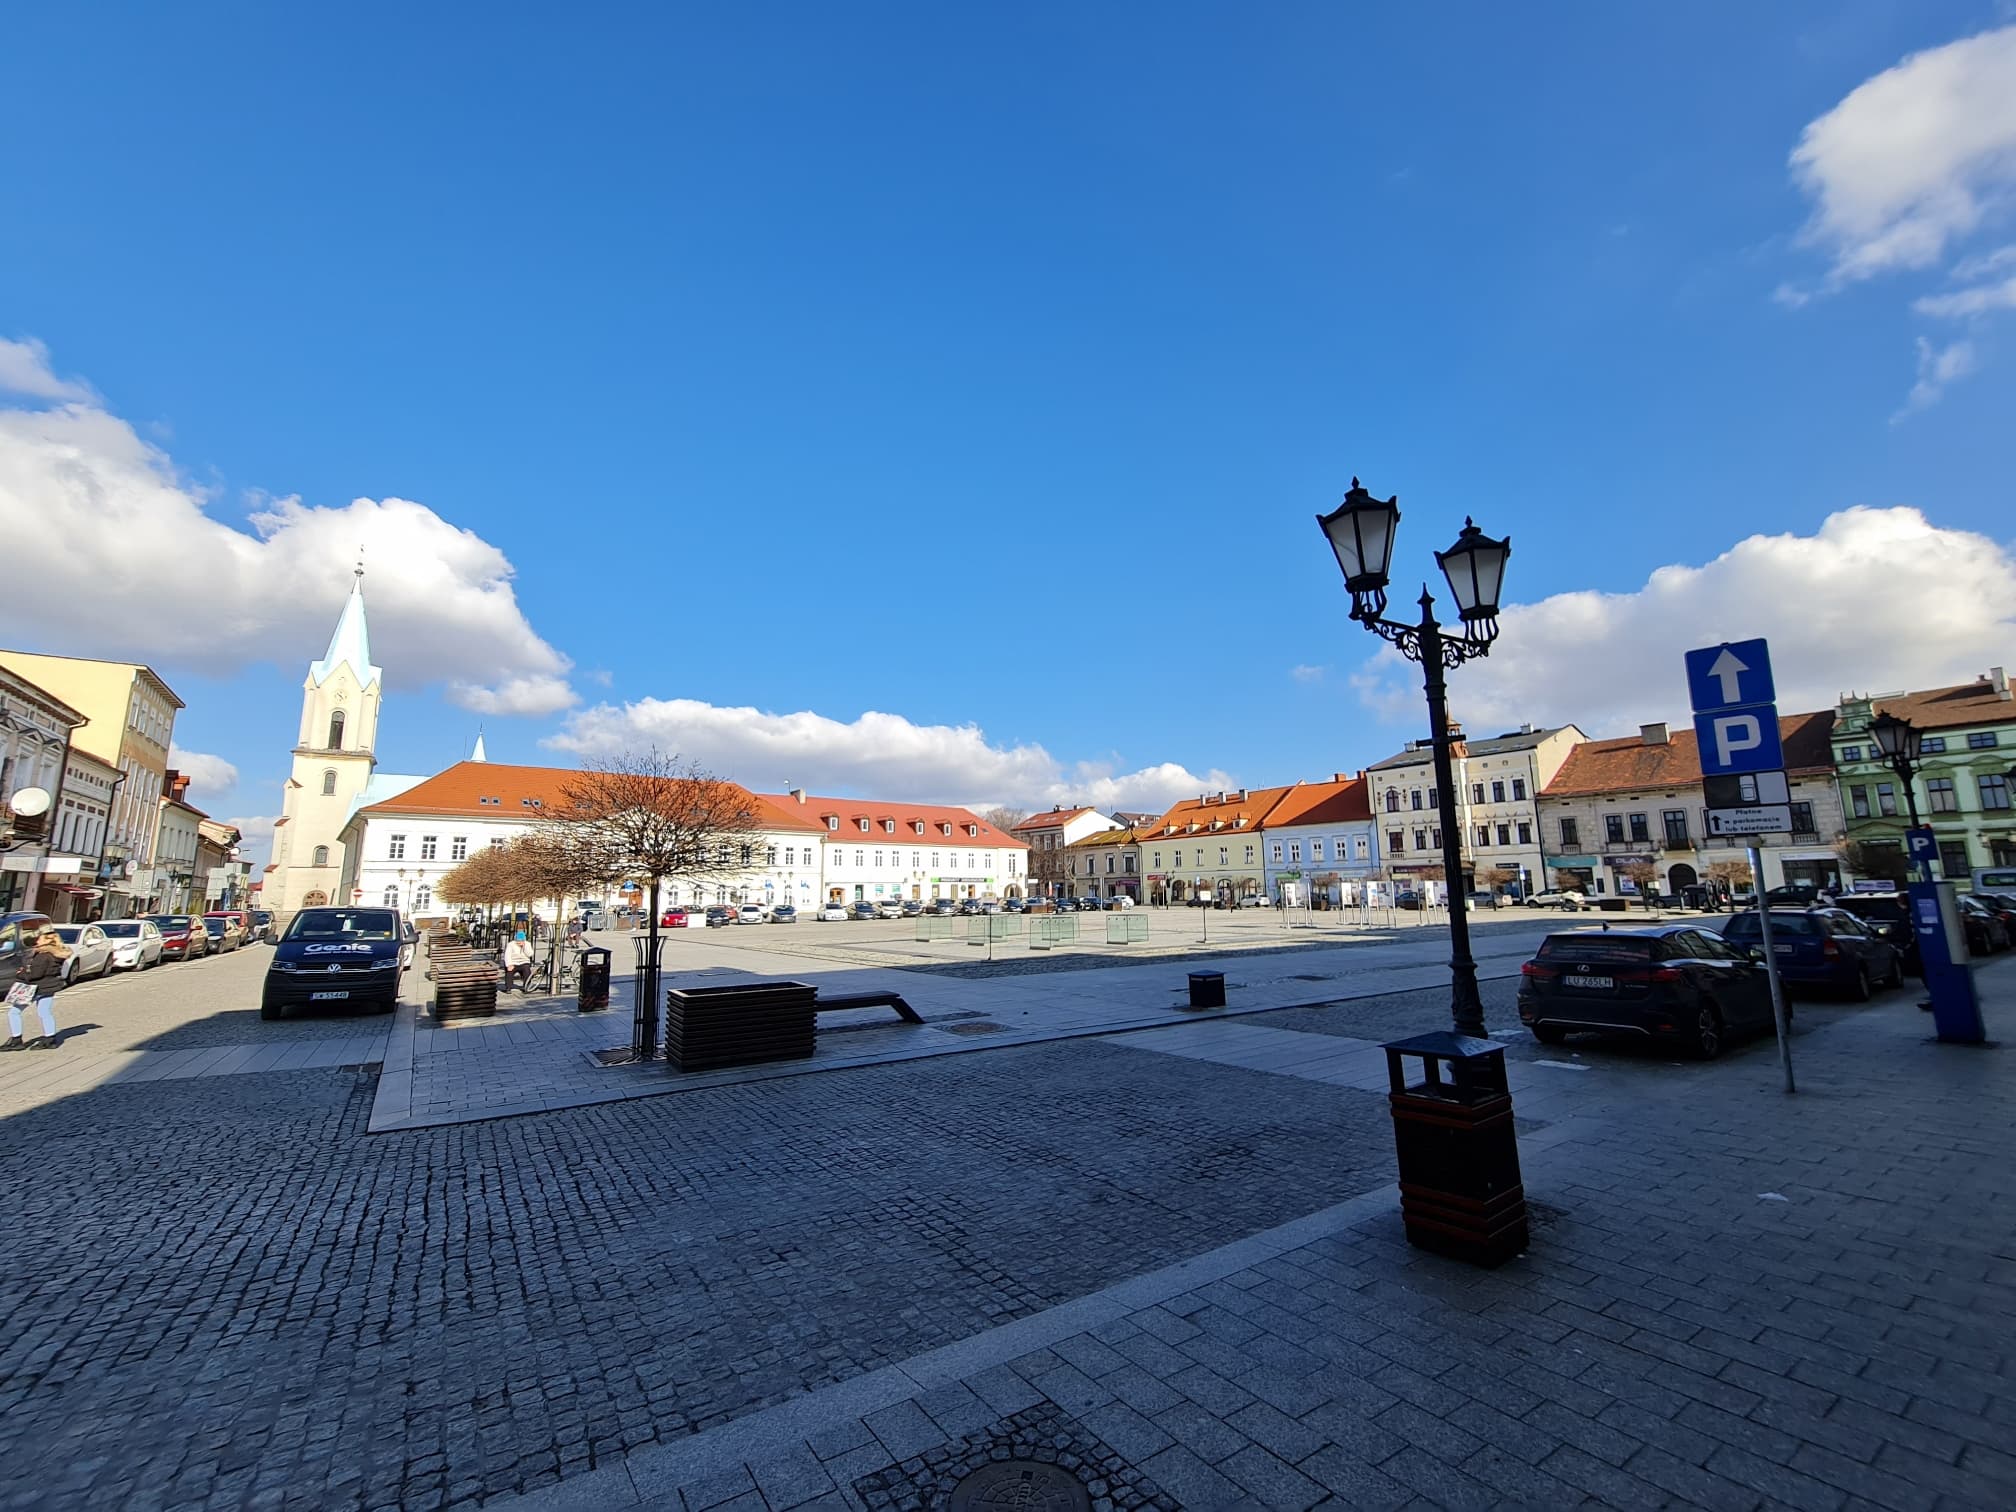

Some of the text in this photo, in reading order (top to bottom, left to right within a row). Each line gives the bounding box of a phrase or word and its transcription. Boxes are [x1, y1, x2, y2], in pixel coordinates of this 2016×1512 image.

[1714, 714, 1761, 766] P
[1911, 837, 1929, 851] P
[305, 943, 372, 951] Genie
